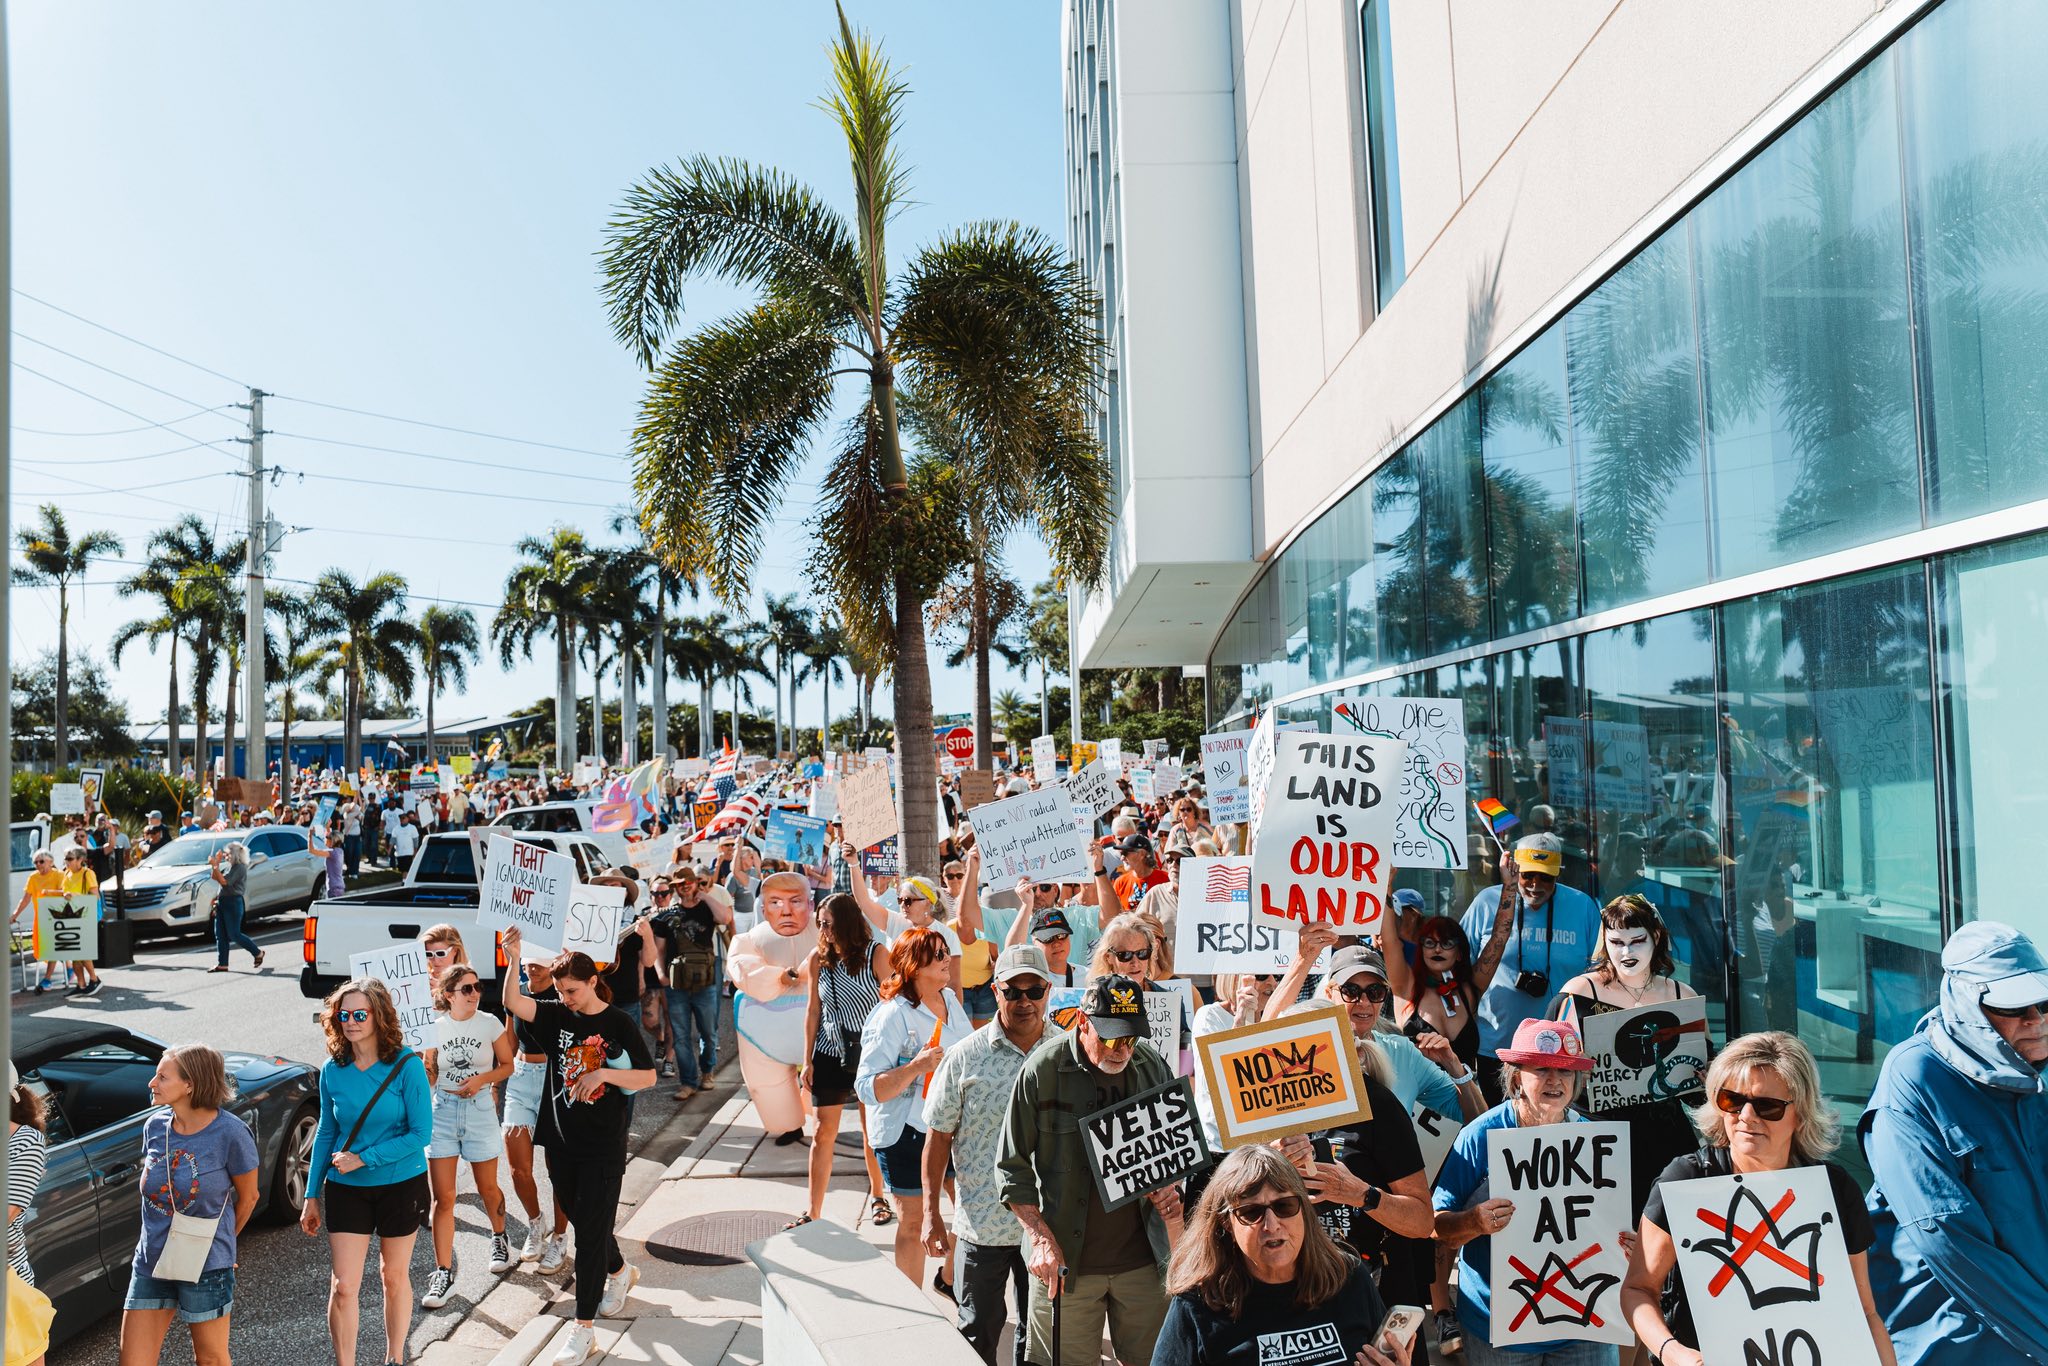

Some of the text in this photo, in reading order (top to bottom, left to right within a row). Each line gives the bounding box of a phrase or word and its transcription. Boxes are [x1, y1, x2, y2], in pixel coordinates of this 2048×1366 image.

[947, 736, 974, 751] STOP
[1215, 737, 1243, 752] TAXATION
[1298, 741, 1376, 773] THIS
[1065, 770, 1088, 791] THEY
[1213, 760, 1231, 778] NO
[1070, 773, 1106, 802] RMALIZED
[1082, 784, 1109, 803] TLER
[1287, 775, 1382, 809] LAND
[694, 802, 717, 816] NO
[972, 798, 1057, 835] We are NOT radical
[1072, 806, 1091, 814] EVE:
[1217, 812, 1249, 822] UNDER THE
[980, 817, 1076, 860] We just paid Attention
[1316, 813, 1348, 838] IS
[512, 843, 548, 874] FIGHT
[866, 845, 880, 853] NO
[986, 846, 1076, 881] In History class
[1290, 835, 1380, 884] OUR
[495, 861, 557, 895] IGNORANCE
[511, 886, 534, 908] NOT
[1261, 883, 1382, 927] LAND
[490, 897, 553, 930] IMMIGRANTS
[568, 902, 624, 946] SIST
[1197, 922, 1281, 954] RESIST
[1535, 928, 1577, 945] MXICO
[382, 951, 427, 980] WILL
[1274, 953, 1290, 965] NO
[442, 1035, 483, 1052] AMERICA
[1232, 1052, 1273, 1088] NO
[1590, 1068, 1642, 1083] MERCY
[1591, 1053, 1611, 1069] NO
[1240, 1072, 1336, 1113] DICTATORS
[1593, 1084, 1621, 1099] FOR
[1594, 1093, 1653, 1112] FASCISM
[1088, 1084, 1189, 1151] VETS
[1276, 1101, 1306, 1112] NOKINGS.ORG
[1102, 1117, 1201, 1179] AGAINST
[1502, 1134, 1618, 1191] WOKE
[1115, 1146, 1196, 1198] TRUMP
[1533, 1195, 1595, 1244] AF
[1285, 1326, 1335, 1355] ACLU
[1301, 1351, 1325, 1362] LIBERTIES
[1325, 1348, 1339, 1356] UNION
[1743, 1328, 1821, 1366] NO
